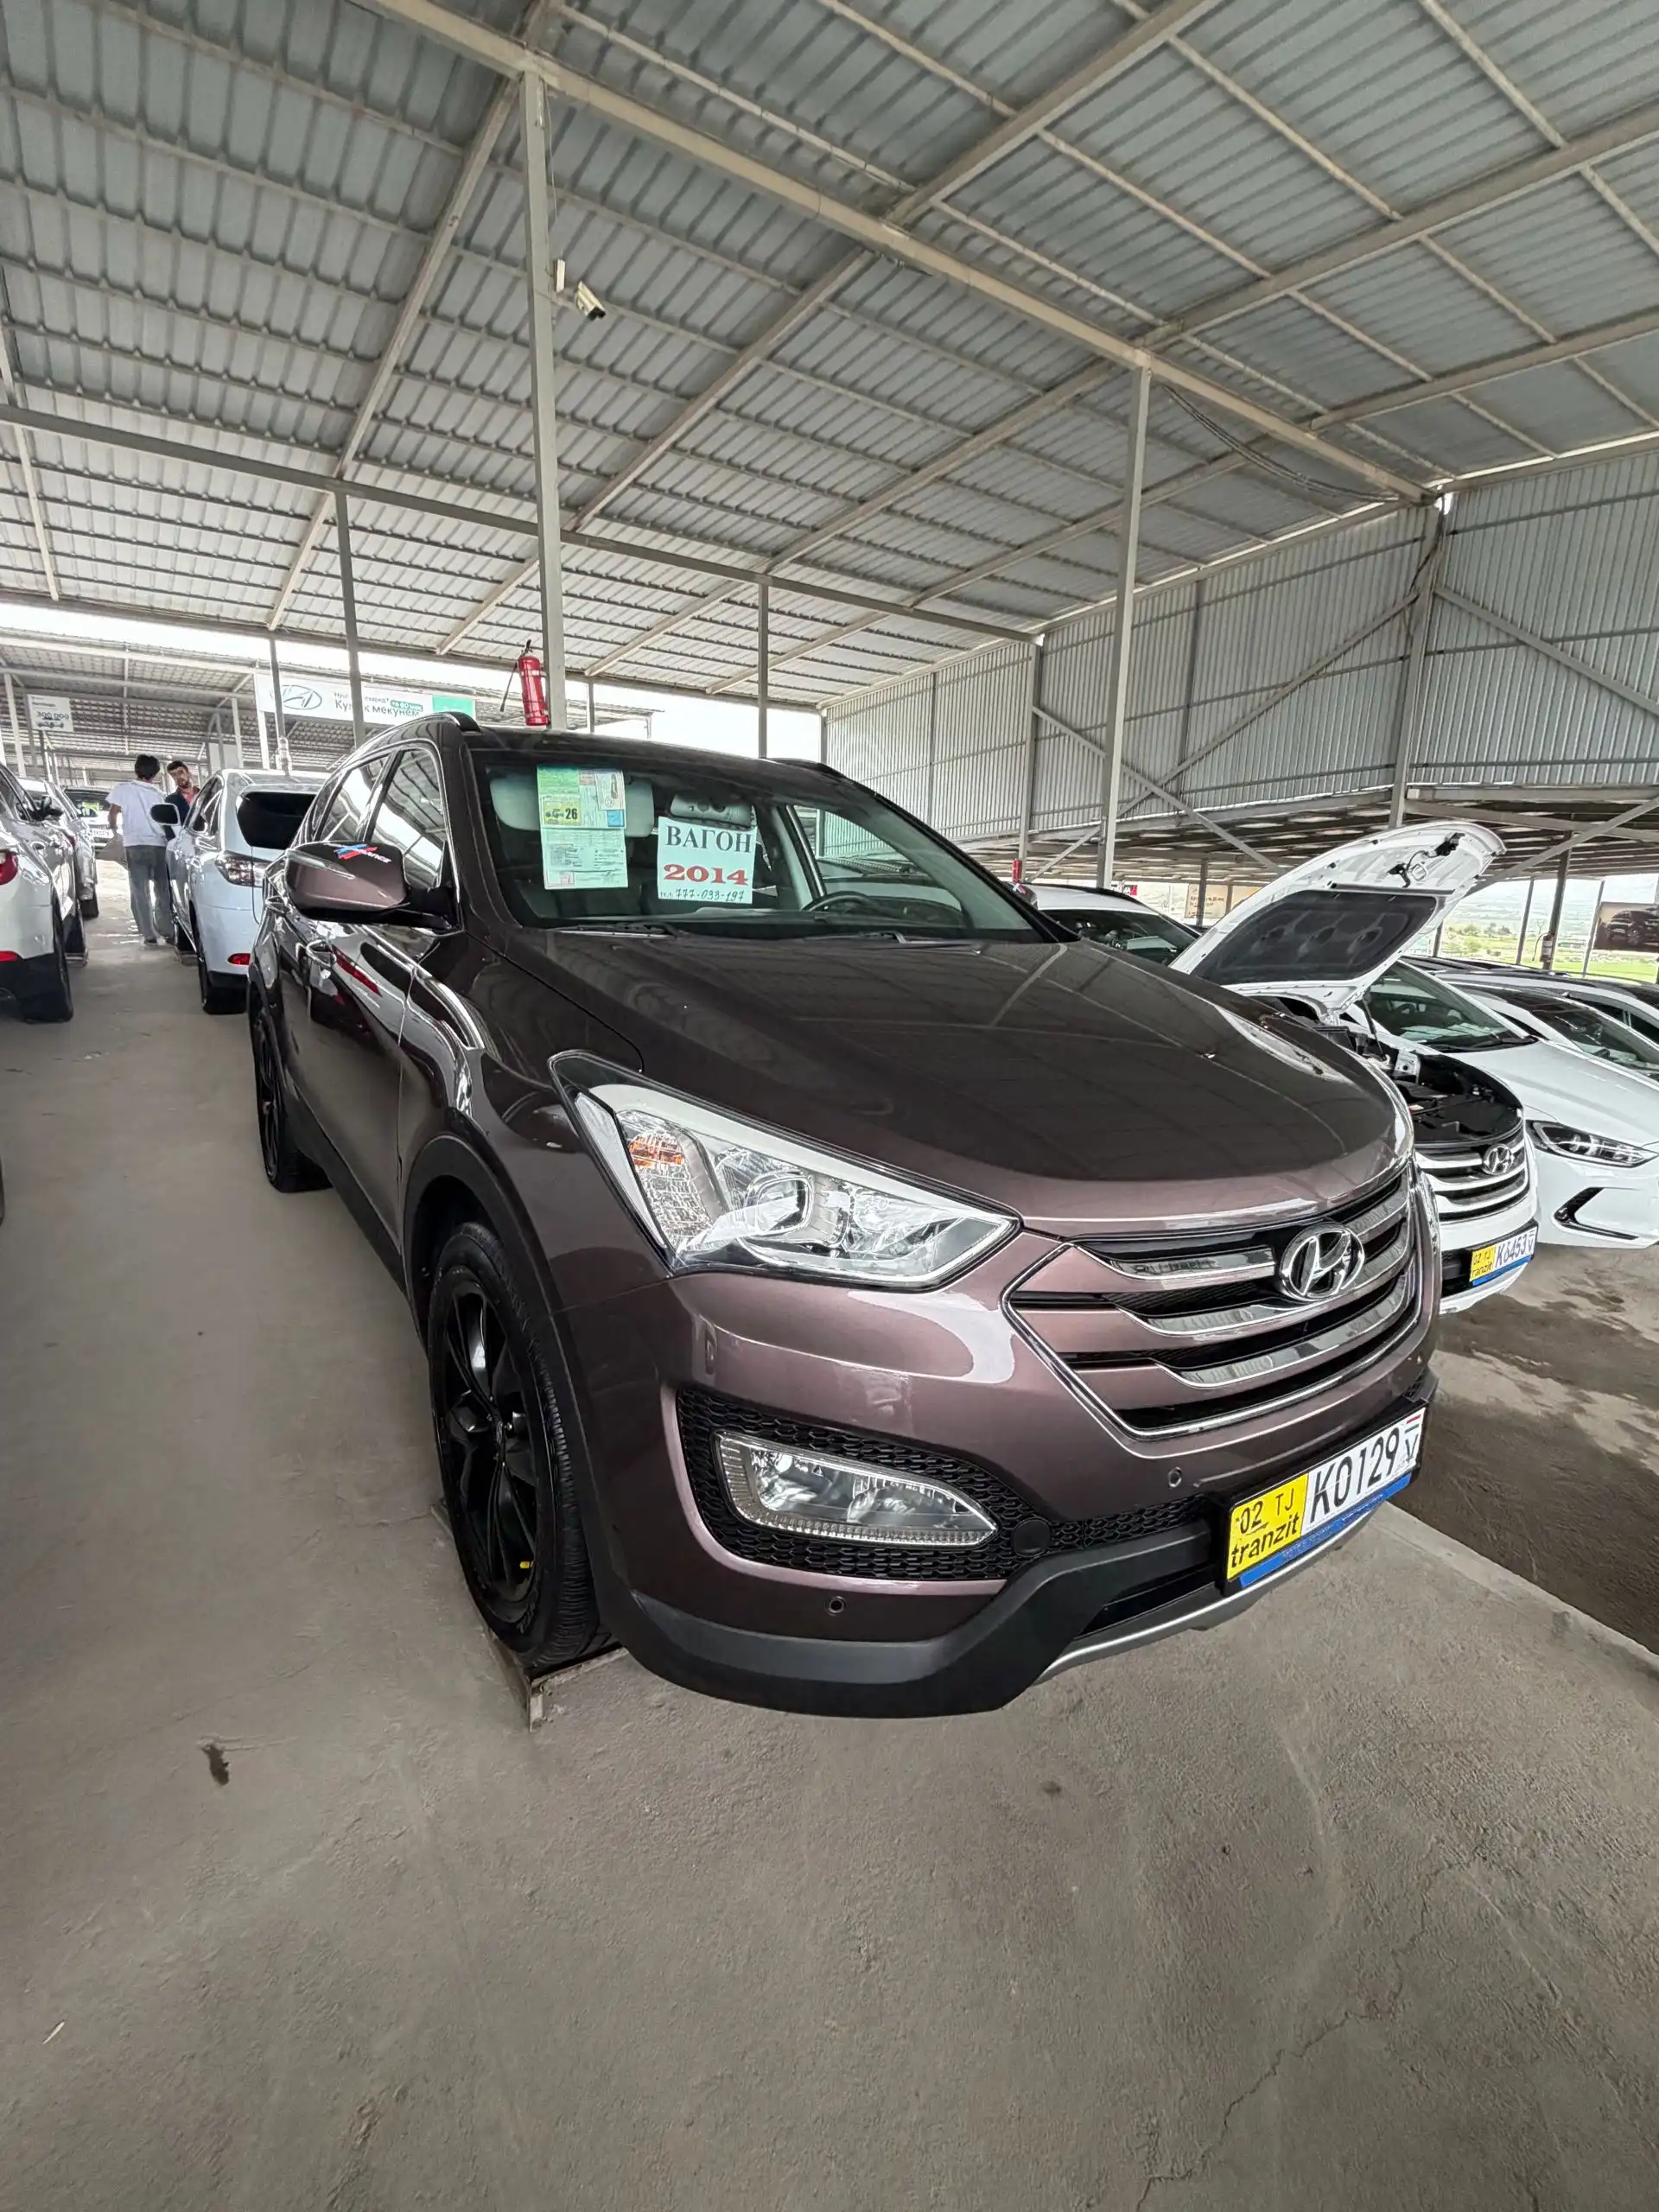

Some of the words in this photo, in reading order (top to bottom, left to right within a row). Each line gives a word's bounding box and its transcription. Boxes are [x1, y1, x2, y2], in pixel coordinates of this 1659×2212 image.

[372, 705, 420, 717] мекунем
[564, 807, 578, 821] 26
[666, 825, 752, 854] ВАГОН
[663, 863, 749, 886] 2014
[1239, 1500, 1264, 1535] 02
[1275, 1487, 1294, 1516] TJ
[1230, 1511, 1300, 1568] tranzit
